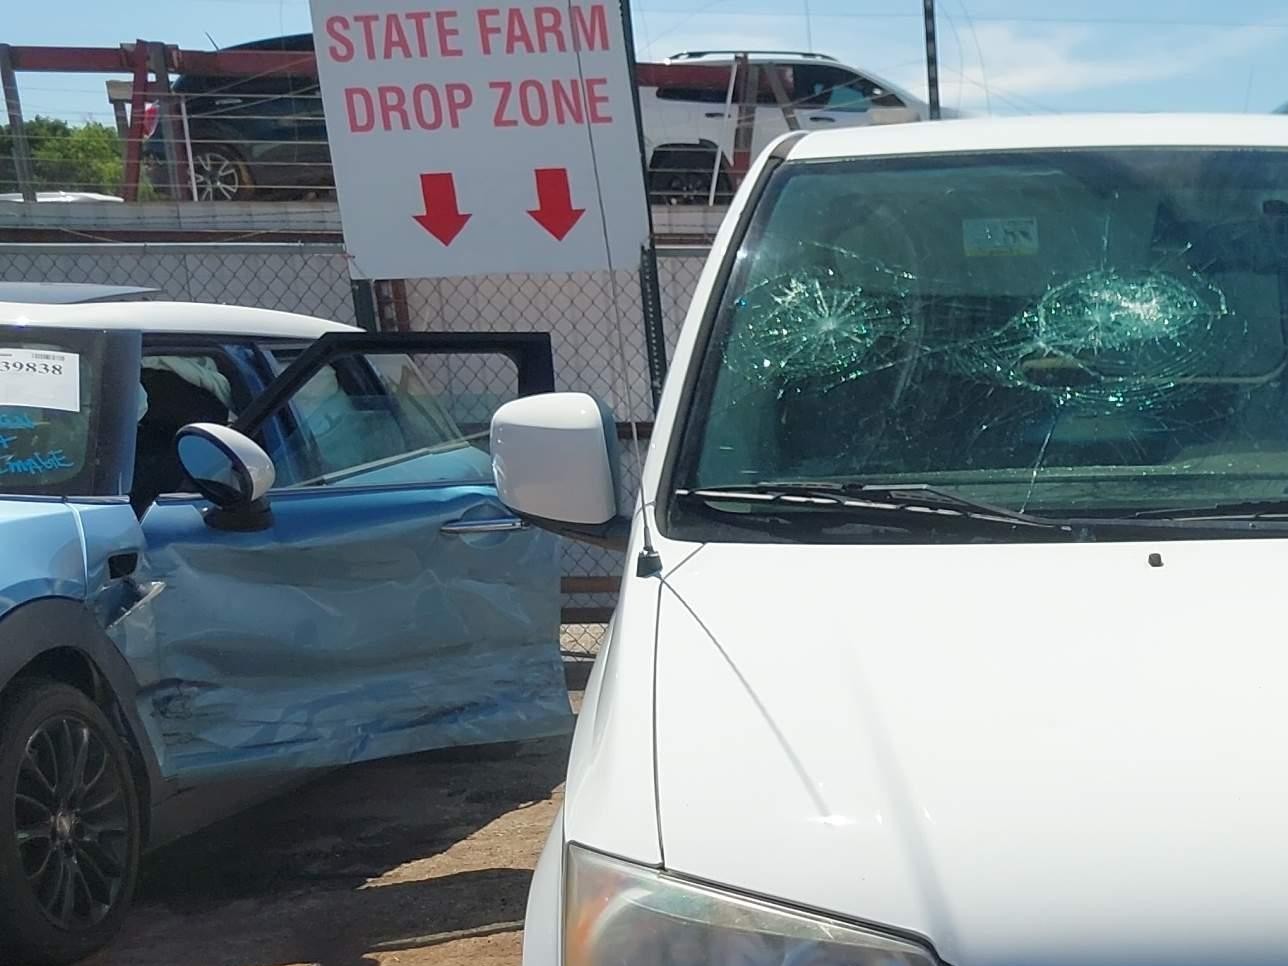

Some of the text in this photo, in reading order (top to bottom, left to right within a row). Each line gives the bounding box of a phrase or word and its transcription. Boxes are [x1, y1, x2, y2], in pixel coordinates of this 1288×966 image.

[325, 4, 611, 63] STATE FARM
[344, 78, 613, 133] DROP ZONE
